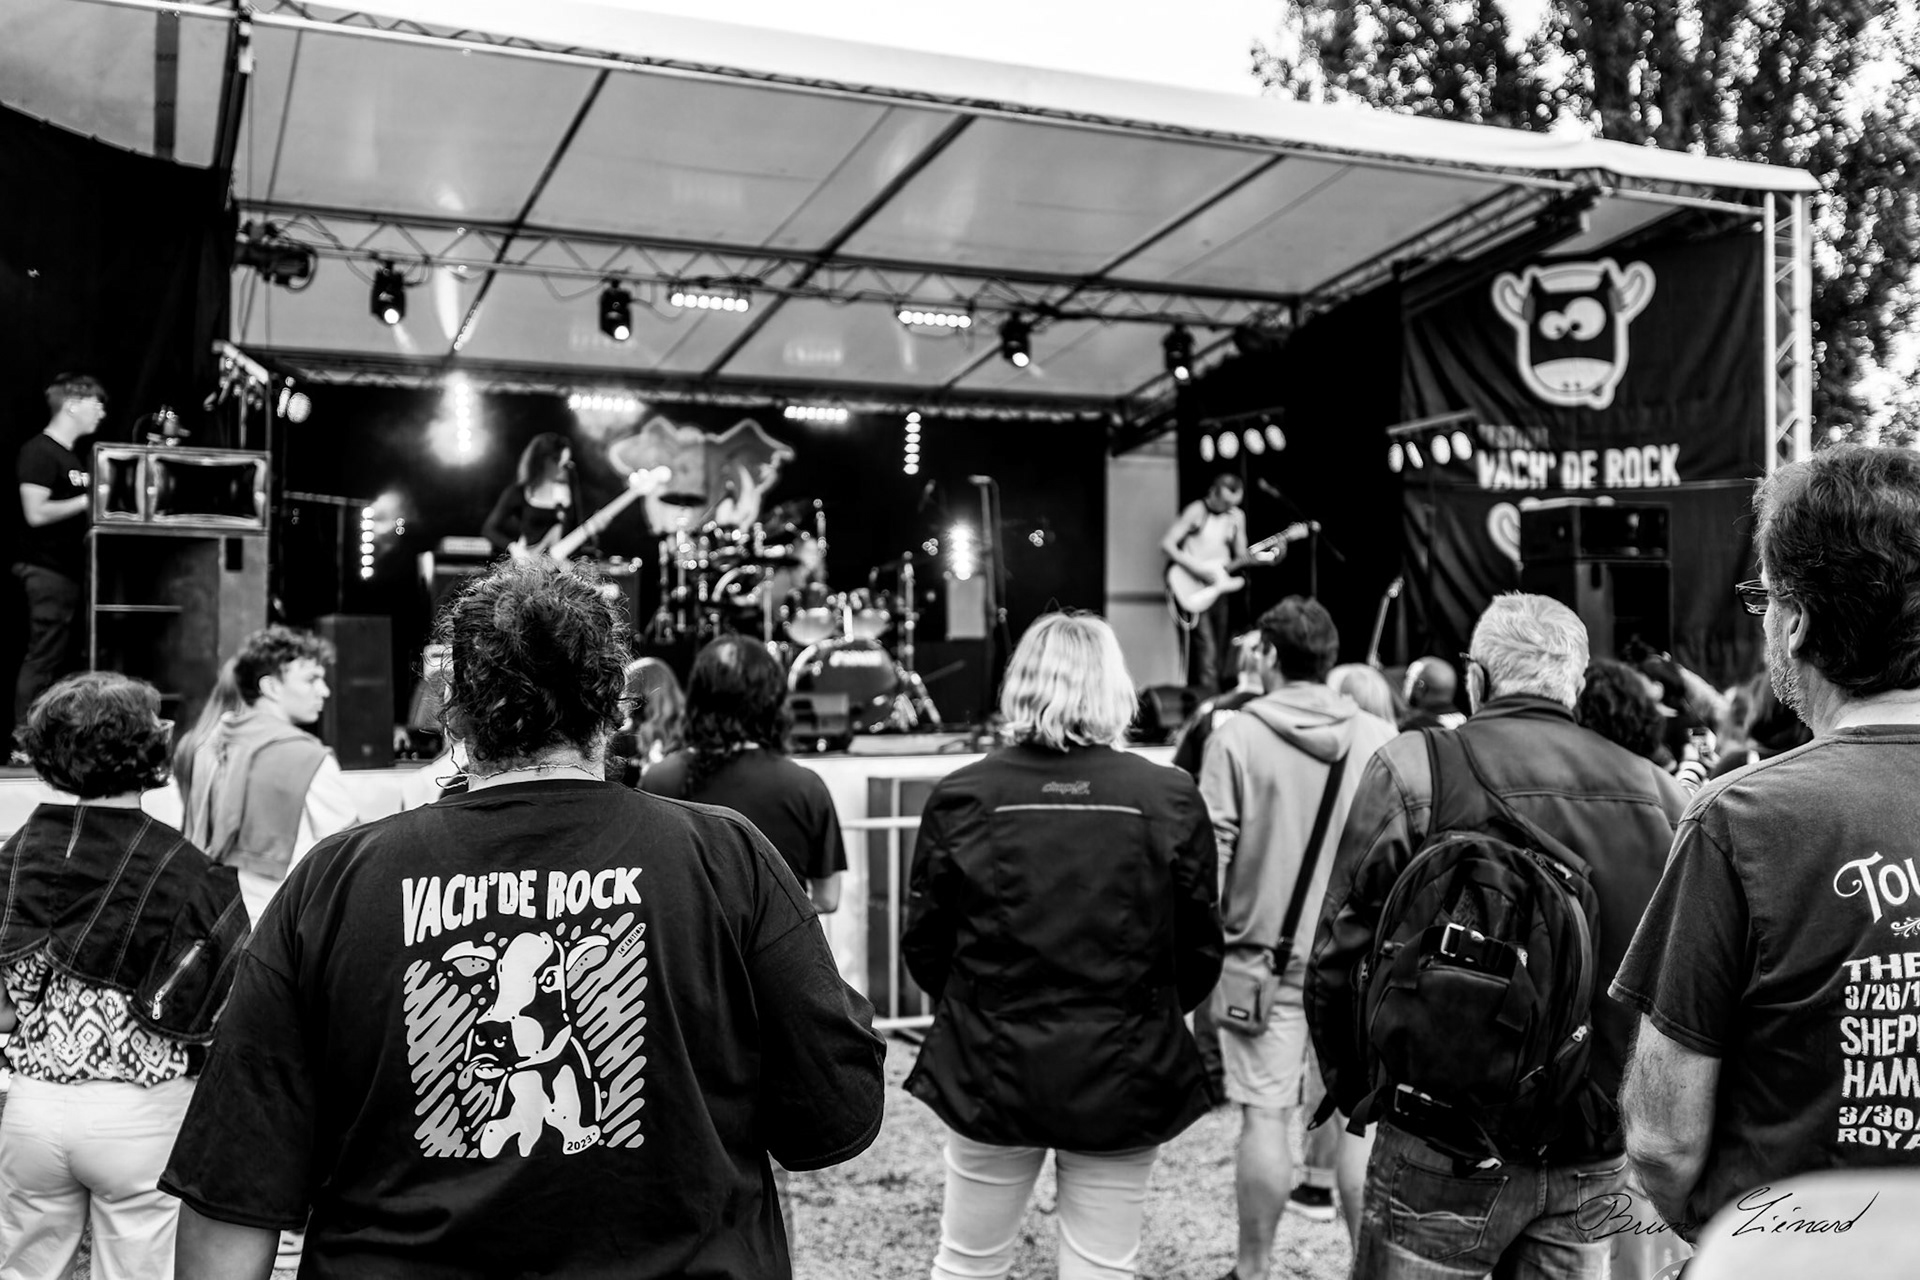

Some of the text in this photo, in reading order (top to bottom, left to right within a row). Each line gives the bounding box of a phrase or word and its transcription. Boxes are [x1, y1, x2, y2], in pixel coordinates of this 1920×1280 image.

[1560, 450, 1599, 490] DE
[1604, 443, 1682, 489] ROCK
[546, 866, 643, 920] ROCK
[1842, 952, 1920, 982] THE
[1840, 1014, 1920, 1056] SHEP
[1842, 1057, 1920, 1098] HAM
[566, 1134, 593, 1151] 2023
